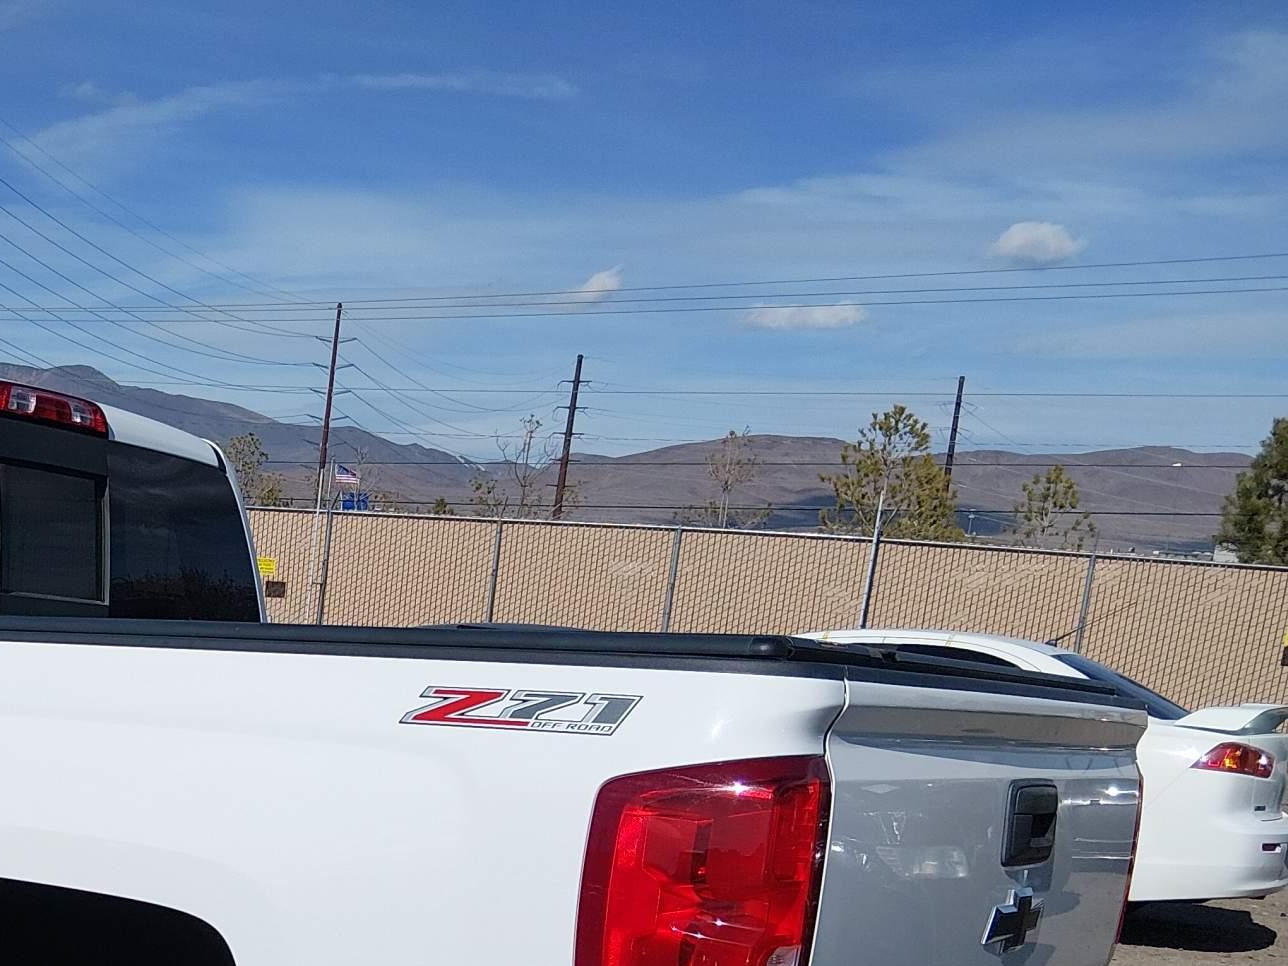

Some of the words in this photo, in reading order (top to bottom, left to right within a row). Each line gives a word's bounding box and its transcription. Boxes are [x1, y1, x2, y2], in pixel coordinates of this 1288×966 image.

[399, 686, 643, 732] Z71
[530, 720, 563, 730] OFF
[565, 722, 613, 733] ROAD
